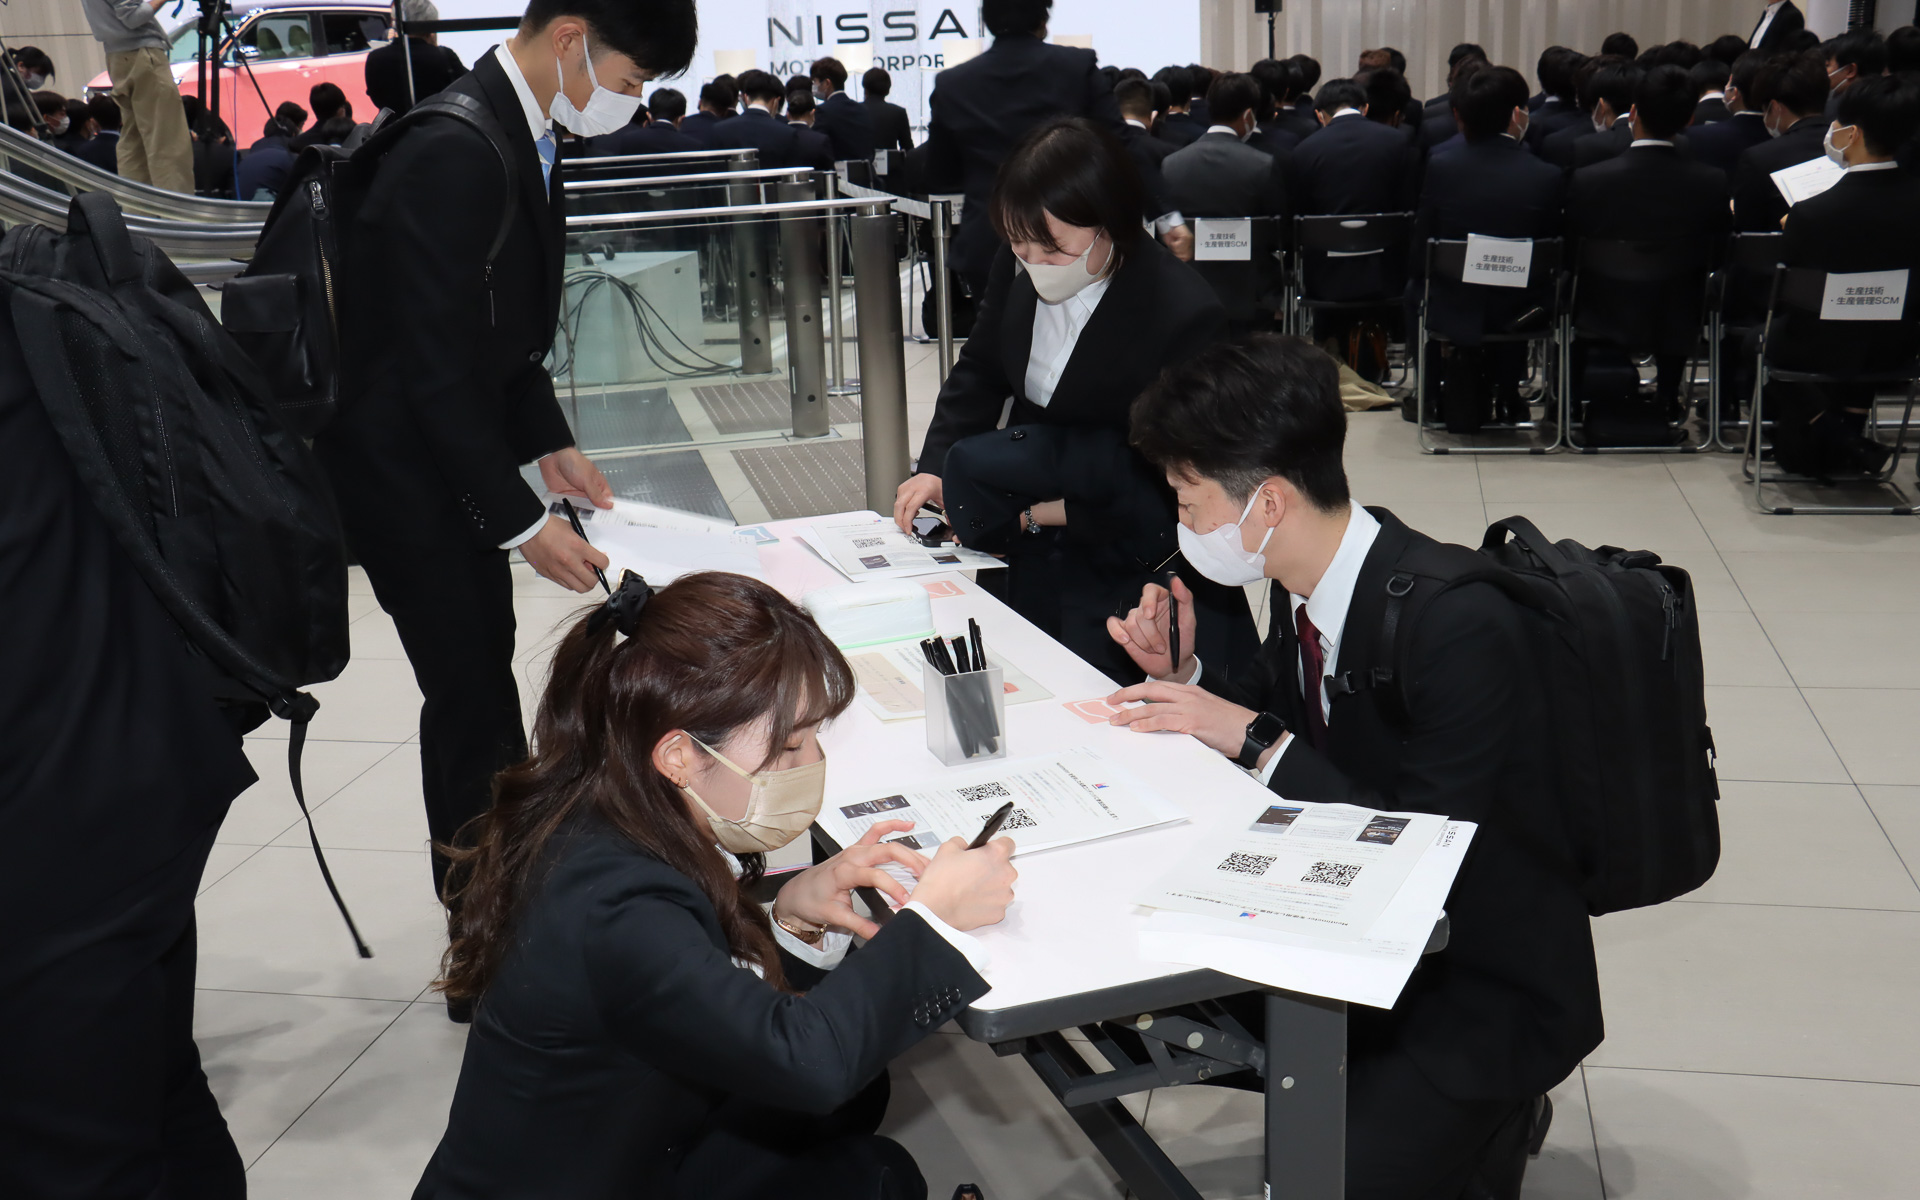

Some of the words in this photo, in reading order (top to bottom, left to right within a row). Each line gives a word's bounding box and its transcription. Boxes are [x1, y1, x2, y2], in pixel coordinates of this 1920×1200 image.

[1483, 254, 1513, 264] 生産技術
[1845, 286, 1884, 295] 生産技術
